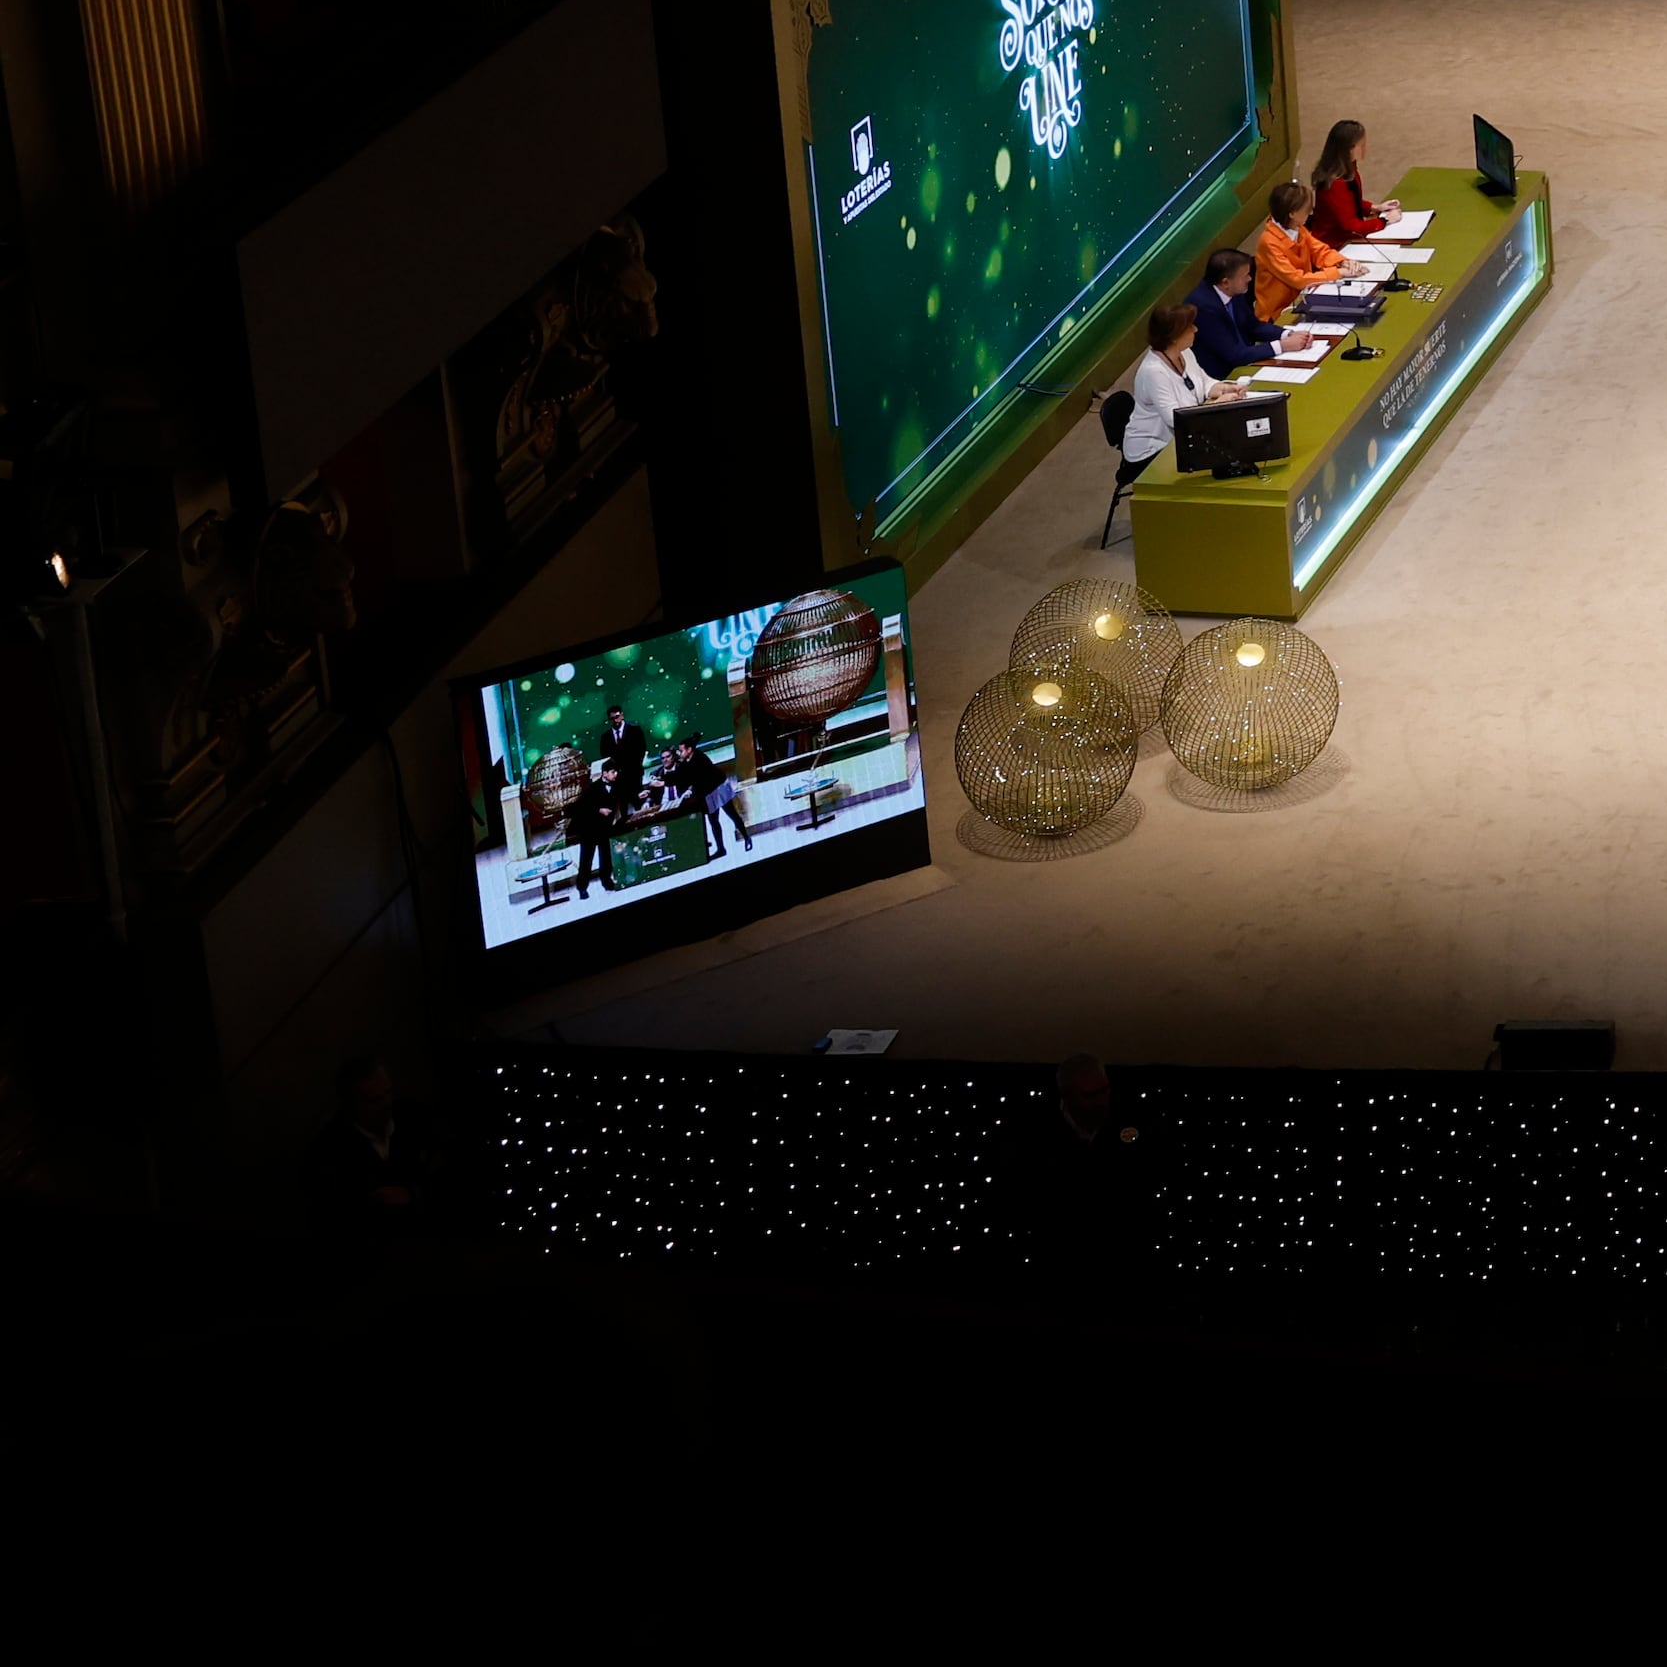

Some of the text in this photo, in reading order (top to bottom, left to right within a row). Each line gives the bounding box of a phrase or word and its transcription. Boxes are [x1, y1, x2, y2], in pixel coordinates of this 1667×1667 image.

[1025, 11, 1059, 69] QUE
[1019, 38, 1082, 160] UNE
[841, 160, 891, 214] LOTERÍAS
